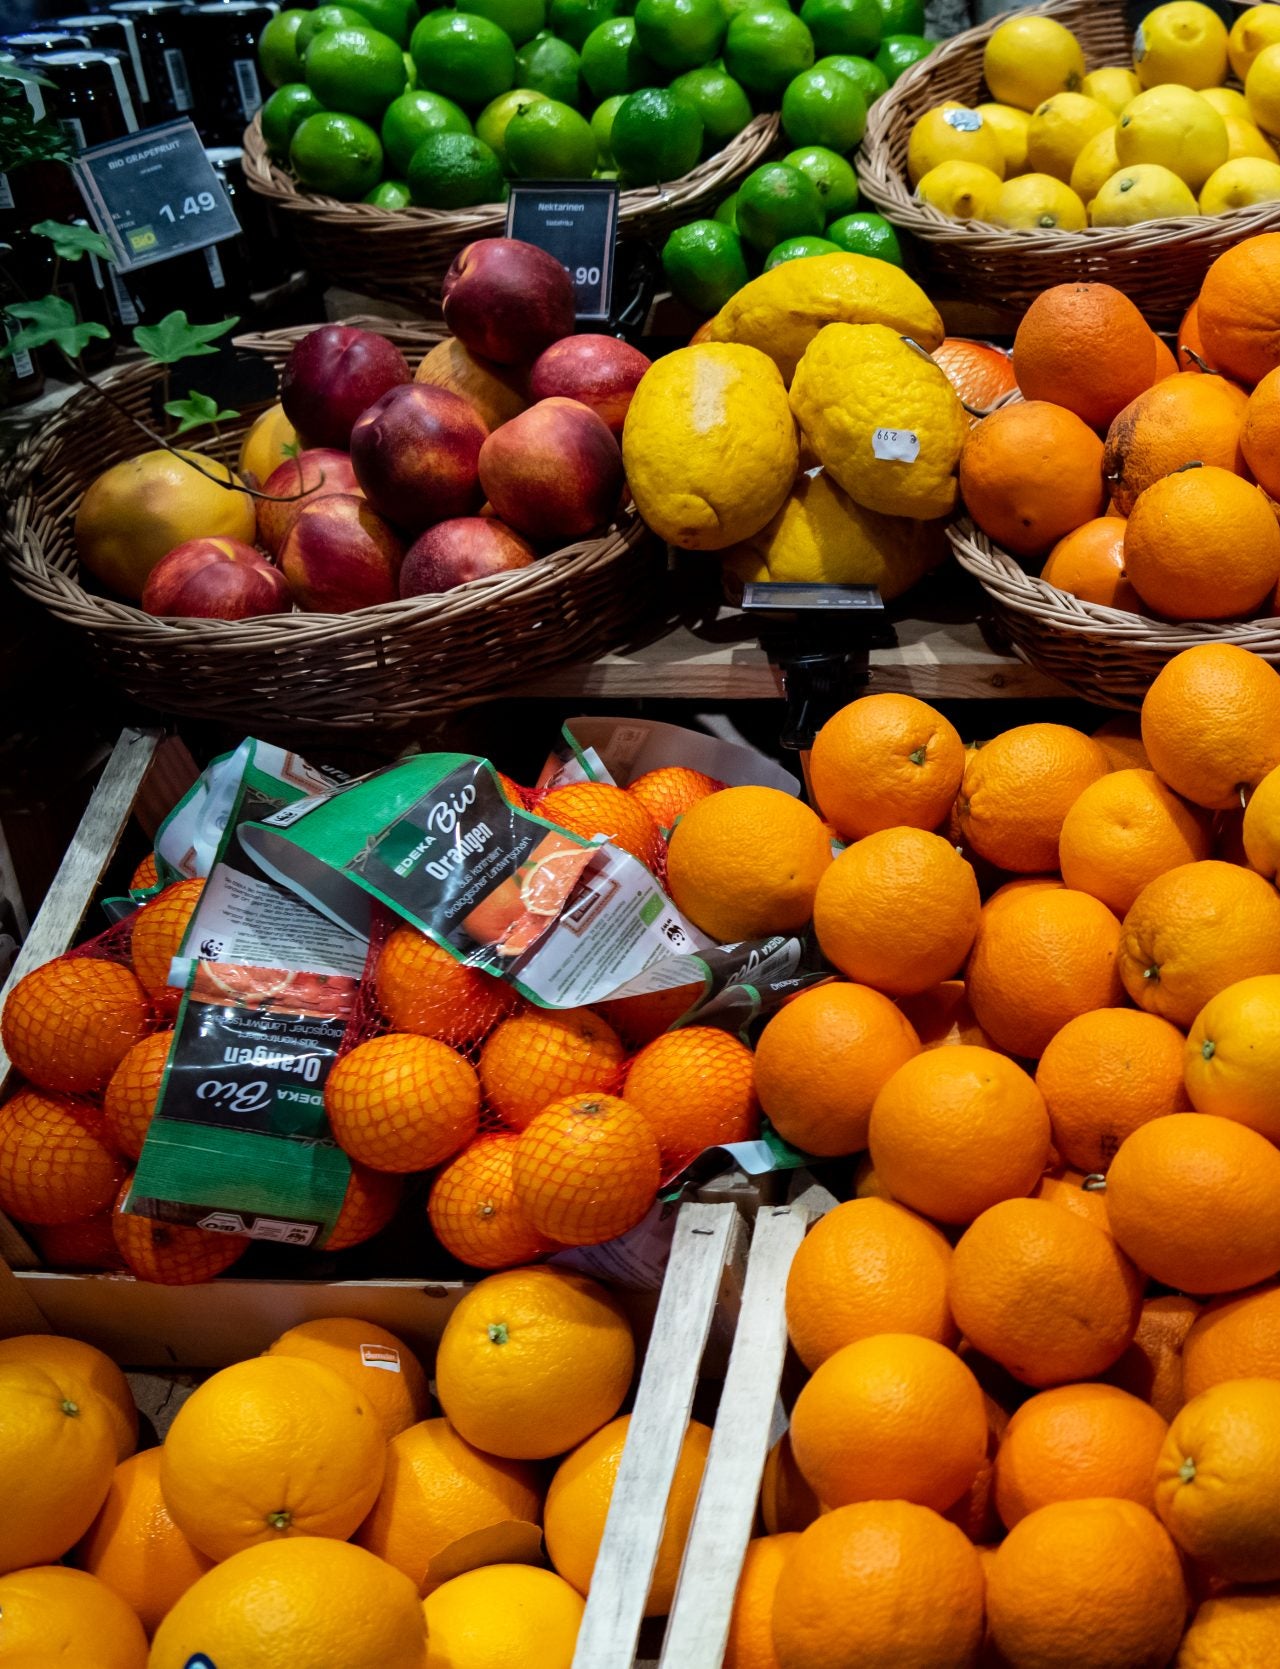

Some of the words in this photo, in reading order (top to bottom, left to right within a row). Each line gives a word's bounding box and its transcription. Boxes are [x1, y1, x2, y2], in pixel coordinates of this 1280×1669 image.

[108, 160, 125, 170] BIO
[126, 140, 180, 165] GRAPEFRUIT
[159, 191, 216, 223] 1.49
[538, 203, 584, 212] Nektarinen
[394, 836, 437, 876] EDEKA
[427, 784, 477, 834] Bio
[425, 822, 494, 881] Orangen
[224, 1046, 321, 1082] Orangen
[196, 1080, 272, 1112] Bio
[277, 1089, 324, 1106] DEKA
